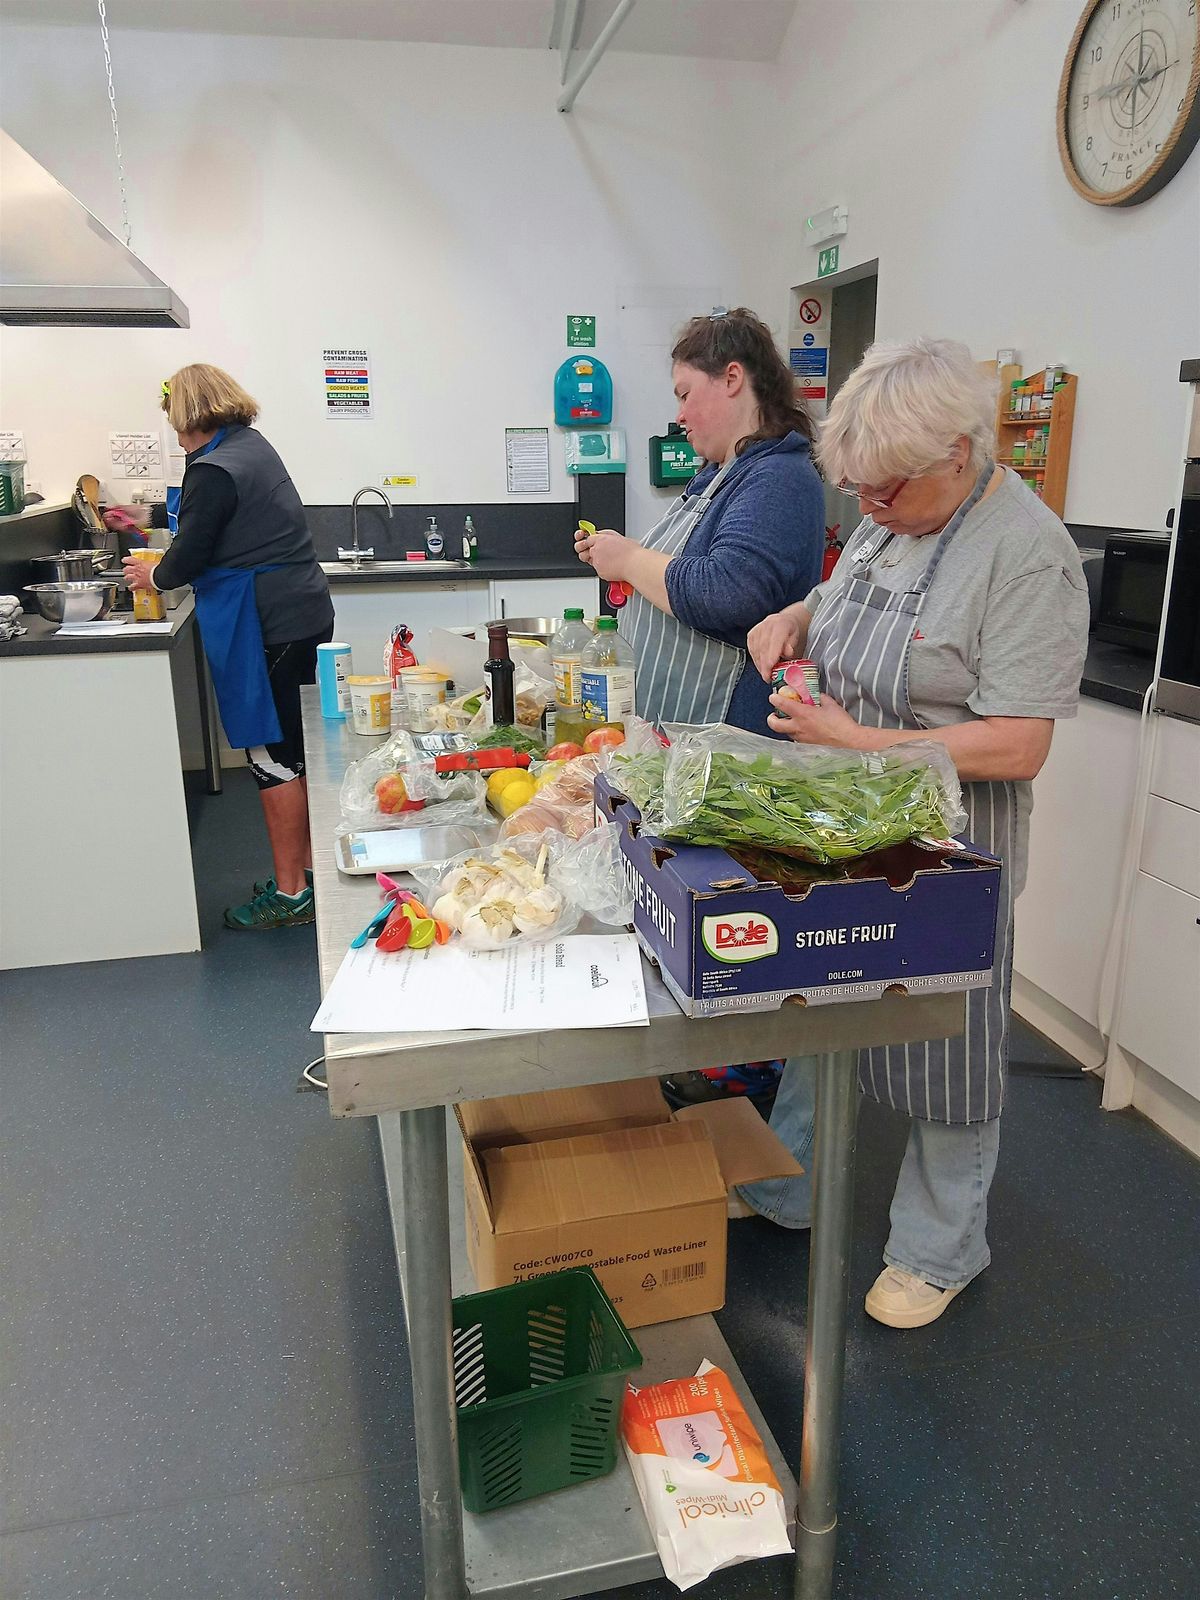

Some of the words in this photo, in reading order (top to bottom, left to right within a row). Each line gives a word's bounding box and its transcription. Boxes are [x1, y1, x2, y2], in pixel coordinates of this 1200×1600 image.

[1112, 3, 1121, 21] 11
[1091, 46, 1103, 65] 10
[1082, 95, 1090, 111] 9
[1086, 136, 1093, 151] 8
[1102, 162, 1108, 177] 7
[1125, 163, 1133, 180] 6
[645, 883, 676, 949] FRUIT
[716, 920, 769, 947] Dole
[795, 928, 847, 948] STONE
[851, 923, 897, 943] FRUIT
[555, 943, 566, 954] Soda
[555, 954, 566, 968] Bread
[827, 969, 863, 981] DOLE.COM
[700, 998, 727, 1011] FRUITS
[728, 998, 734, 1007] A
[735, 995, 762, 1006] NOYAU
[802, 987, 830, 999] FRUTAS
[832, 987, 842, 996] DE
[844, 984, 869, 995] HUESO
[939, 975, 963, 985] STONE
[964, 972, 986, 982] FRUIT
[513, 1259, 543, 1271] Code:
[544, 1248, 593, 1265] CW007C0
[625, 1250, 650, 1262] Food
[653, 1245, 682, 1257] Waste
[683, 1240, 707, 1251] Liner
[684, 1422, 702, 1451] uniwipe
[675, 1494, 728, 1506] Midi-Wipes
[678, 1491, 766, 1529] clinical
